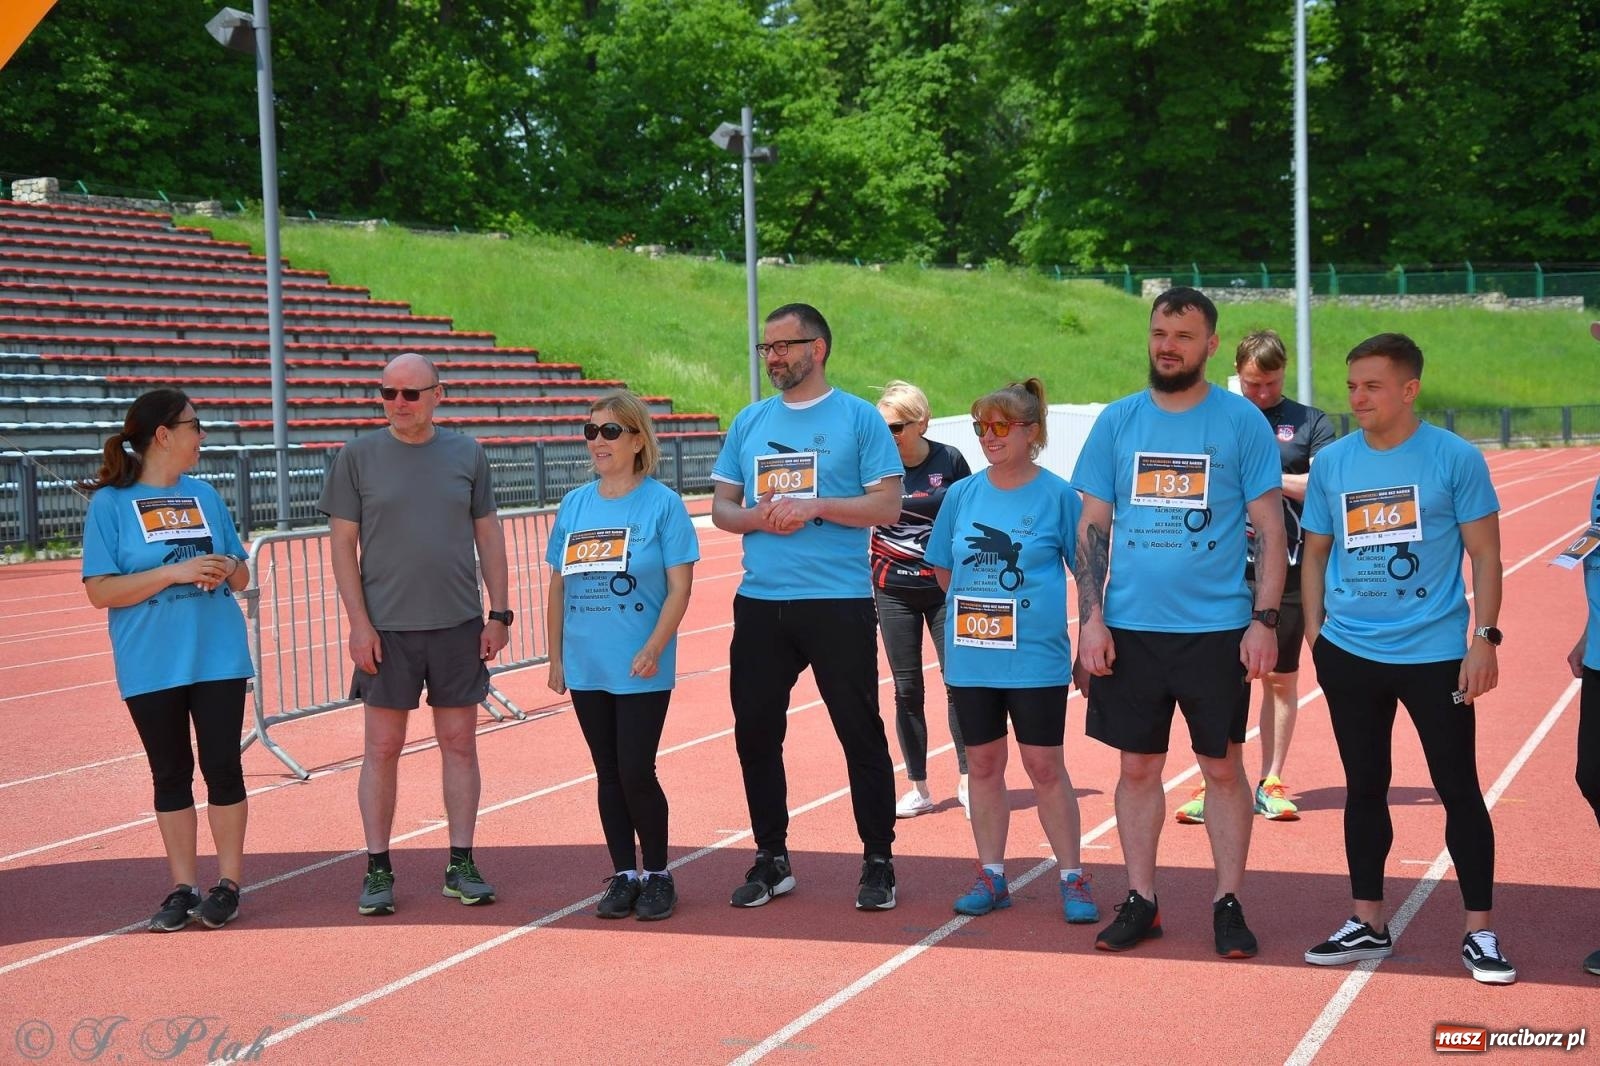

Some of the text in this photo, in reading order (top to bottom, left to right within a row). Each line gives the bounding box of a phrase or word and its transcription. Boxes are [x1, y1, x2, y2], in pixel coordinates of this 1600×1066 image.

[768, 472, 801, 488] 003
[1154, 473, 1190, 494] 133
[156, 510, 191, 526] 134
[1362, 505, 1401, 528] 146
[577, 542, 611, 559] 022
[966, 616, 1001, 636] 005
